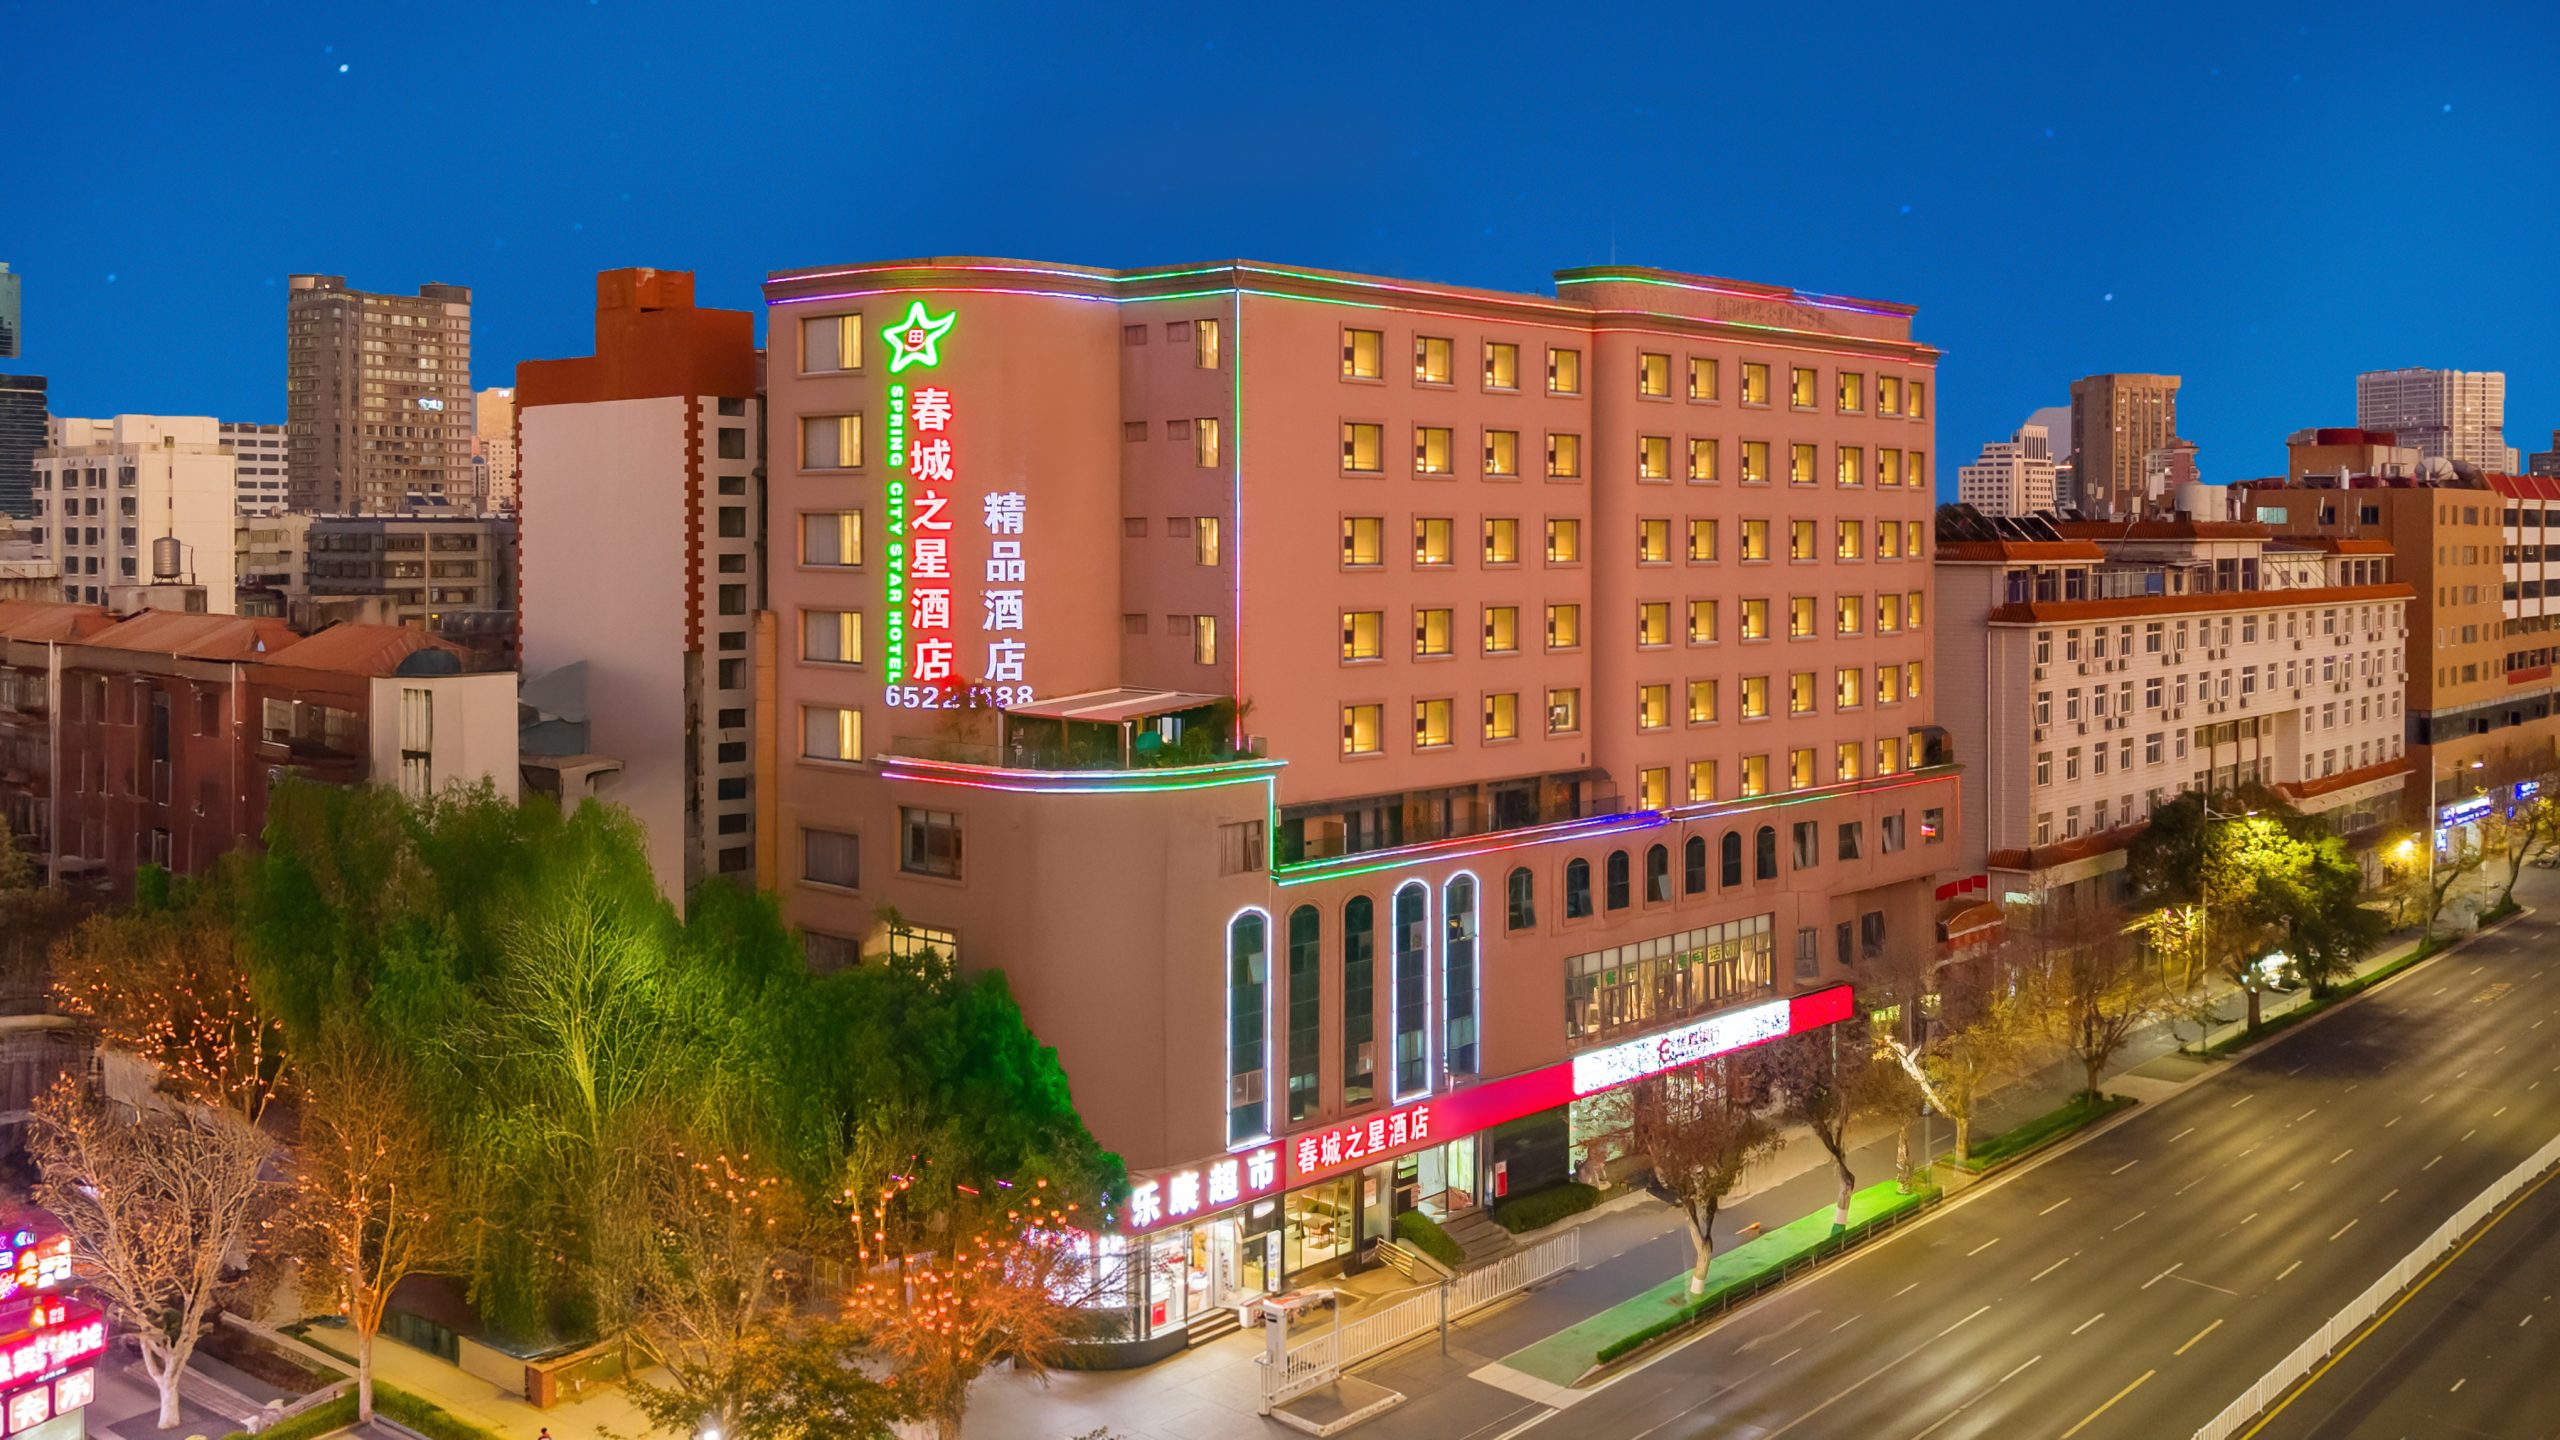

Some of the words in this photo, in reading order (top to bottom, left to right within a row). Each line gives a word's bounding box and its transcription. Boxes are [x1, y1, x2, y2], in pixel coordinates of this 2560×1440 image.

[889, 385, 904, 466] SPRING
[889, 482, 904, 536] CITY
[910, 387, 953, 681] 春城之星酒店
[888, 543, 903, 603] STAR
[982, 491, 1027, 682] 精品酒店
[888, 610, 902, 683] HOTEL
[1297, 1105, 1429, 1174] 春城之星酒店
